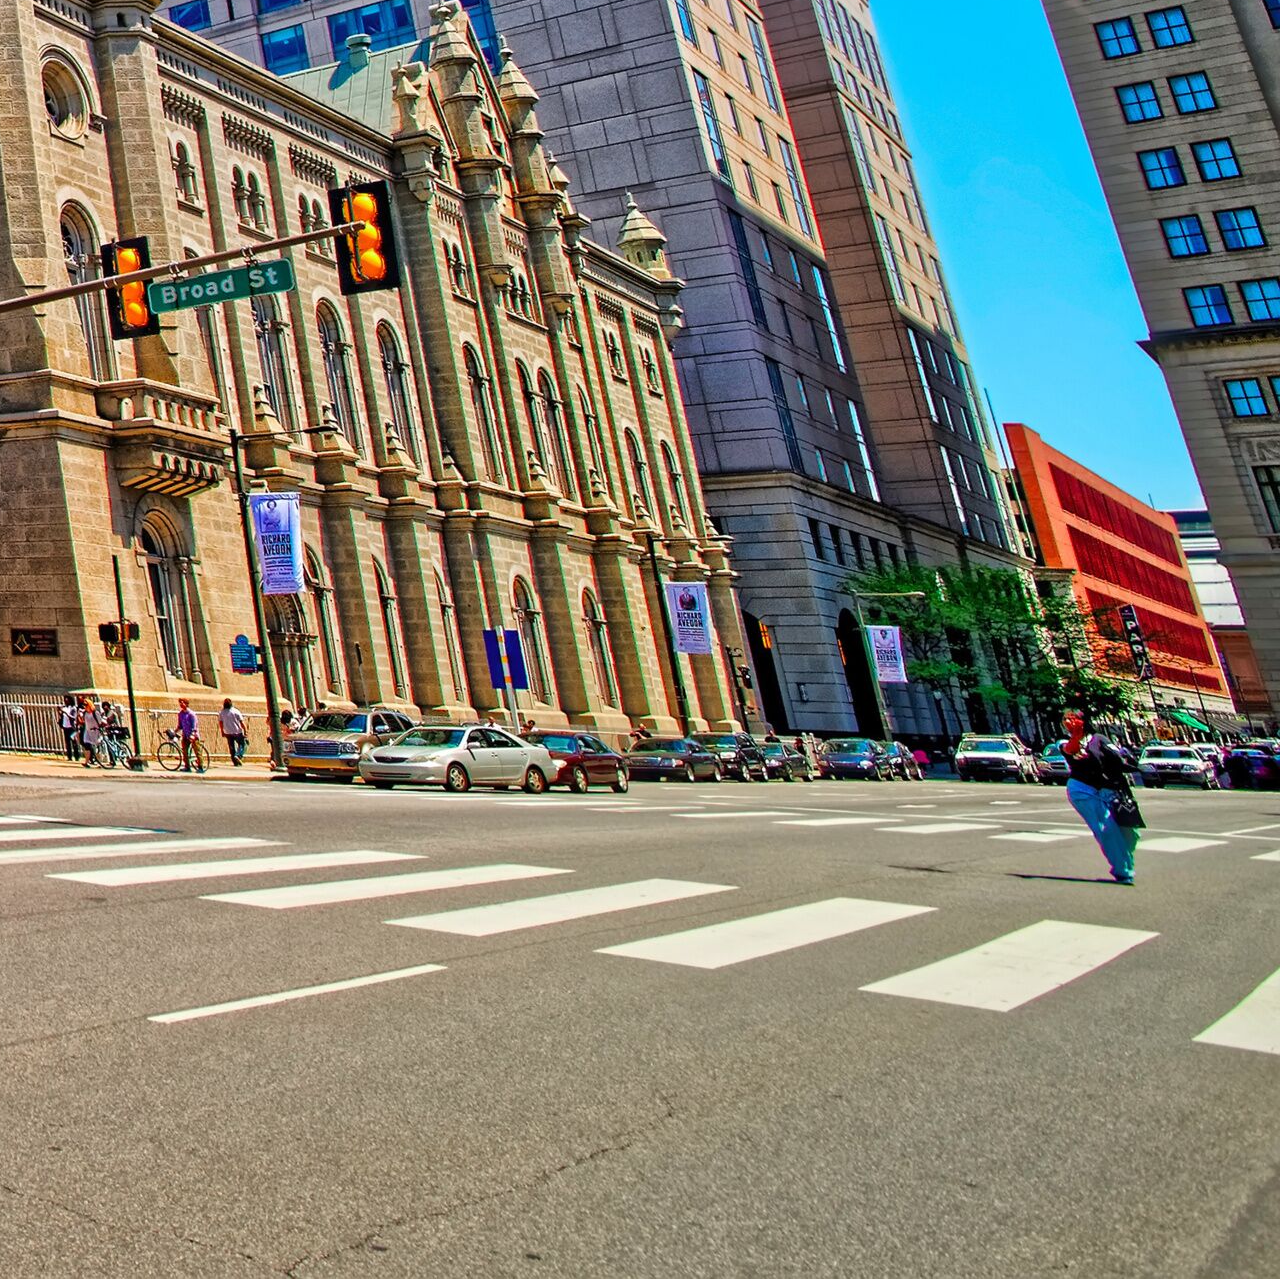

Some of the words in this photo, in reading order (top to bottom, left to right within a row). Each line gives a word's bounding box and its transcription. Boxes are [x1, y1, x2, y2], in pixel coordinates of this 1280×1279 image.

[161, 274, 235, 304] Broad
[249, 266, 278, 288] St
[261, 533, 291, 545] RICHARD
[263, 543, 293, 557] AVEDON
